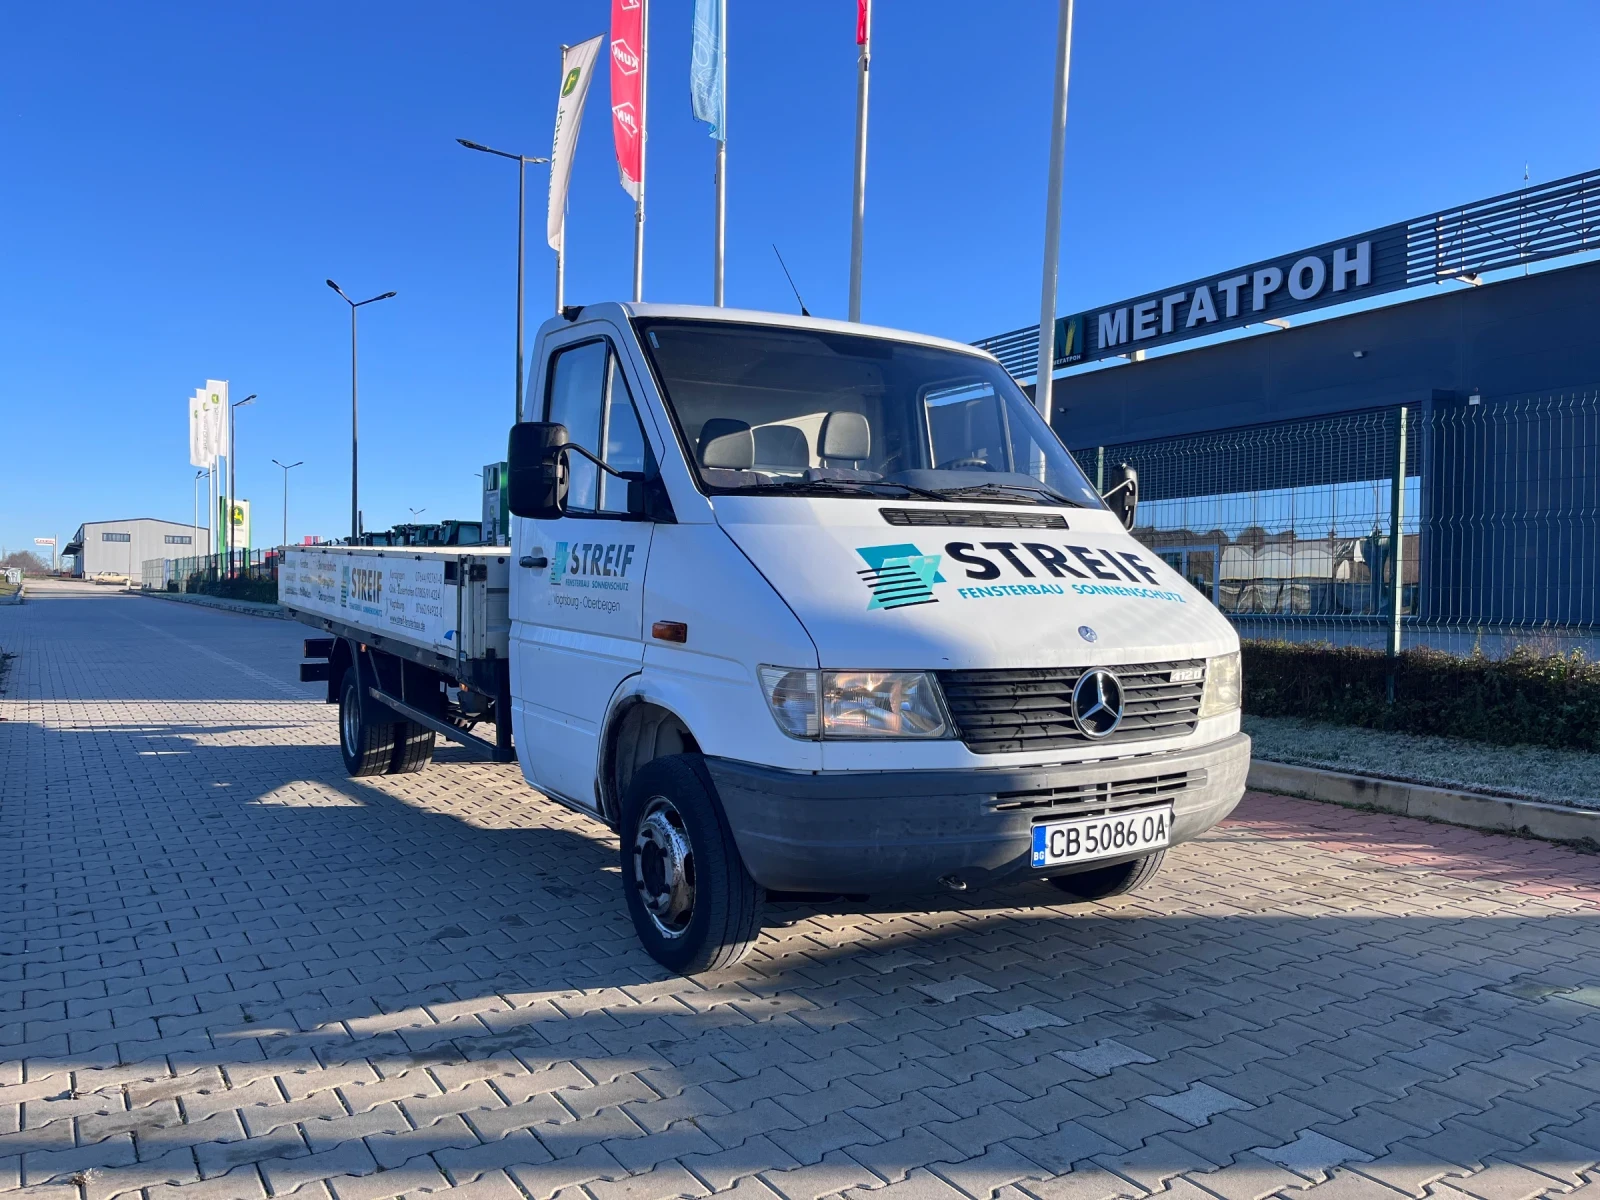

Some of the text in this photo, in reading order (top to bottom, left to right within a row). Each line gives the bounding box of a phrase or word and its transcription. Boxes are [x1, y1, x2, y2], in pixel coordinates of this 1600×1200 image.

[1098, 240, 1371, 349] МЕГАТРОН
[570, 542, 635, 578] STREIF
[945, 542, 1160, 585] STREIF
[351, 567, 383, 604] STREIF
[565, 578, 629, 591] FENSTERBAU SONNENSCHUTZ
[957, 583, 1187, 603] FENSTERBAU SONNENSCHUTZ
[1033, 851, 1045, 861] BG
